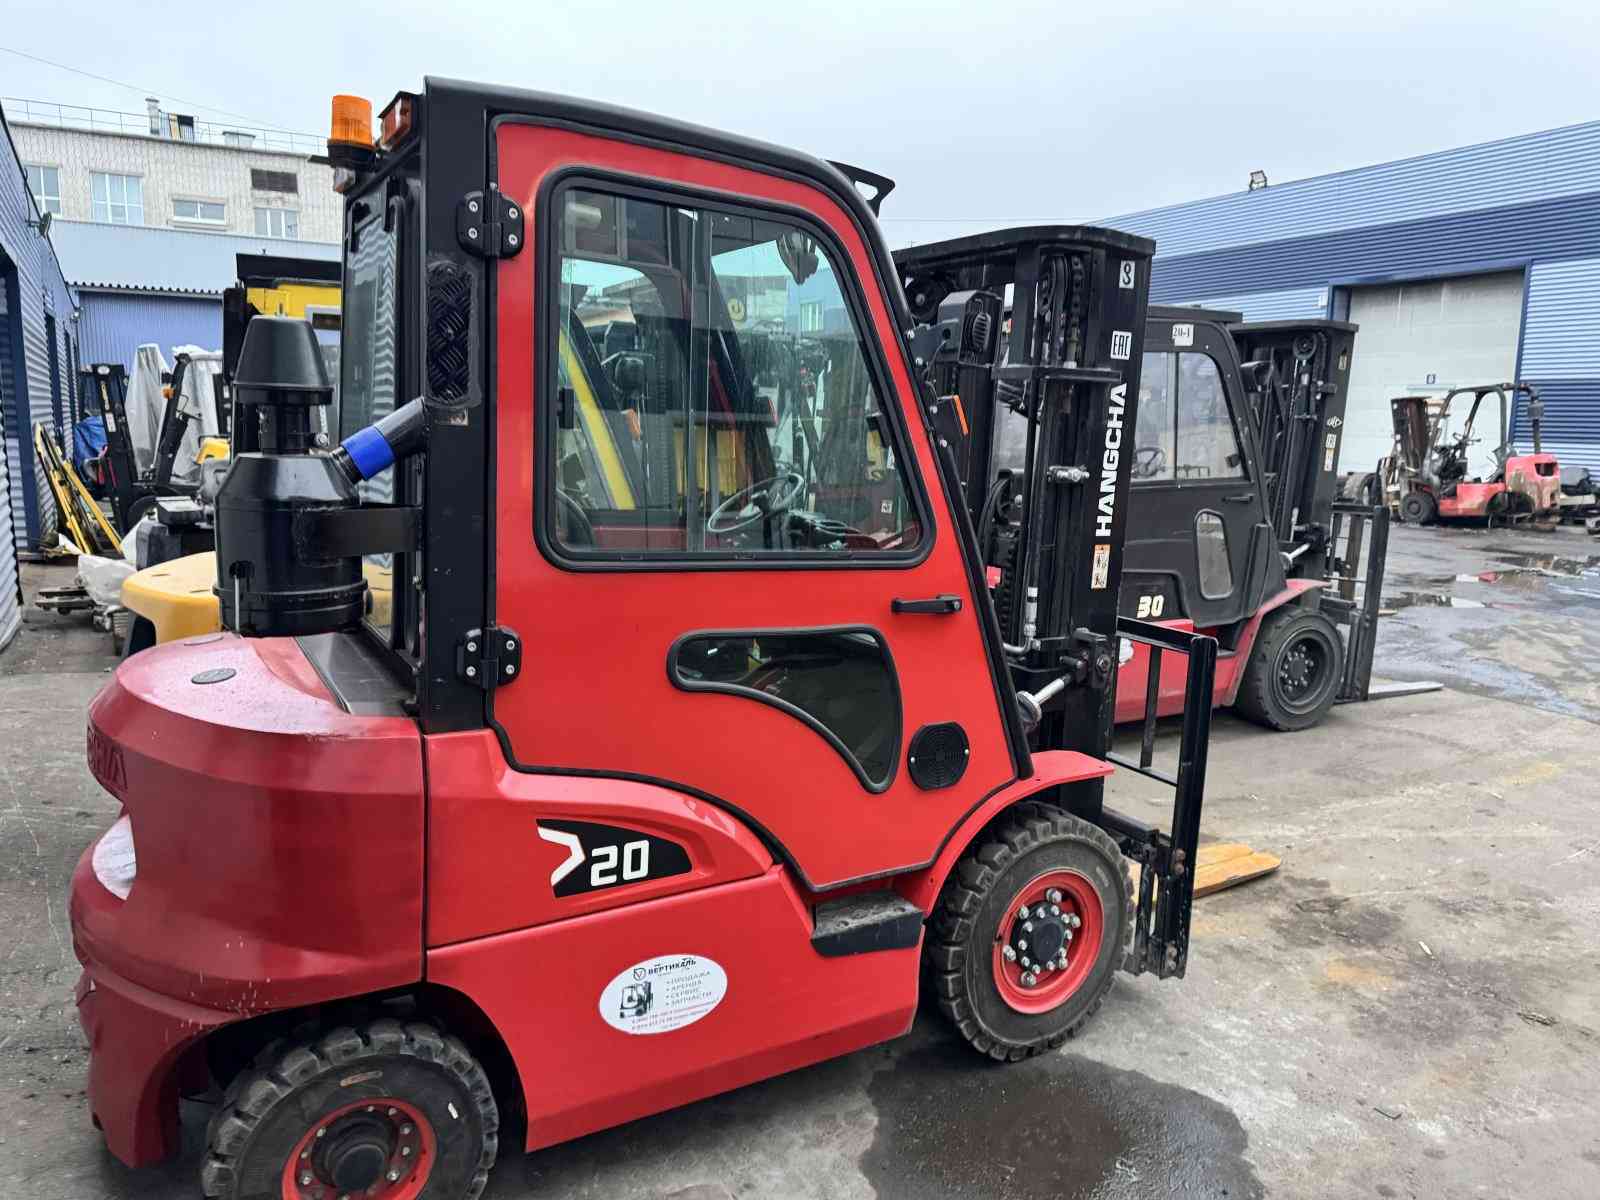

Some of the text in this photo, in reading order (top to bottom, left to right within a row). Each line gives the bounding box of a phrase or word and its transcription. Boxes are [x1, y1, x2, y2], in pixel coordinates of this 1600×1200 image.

[1096, 382, 1127, 537] HANGCHA
[1137, 595, 1164, 619] 30
[590, 839, 650, 887] 20
